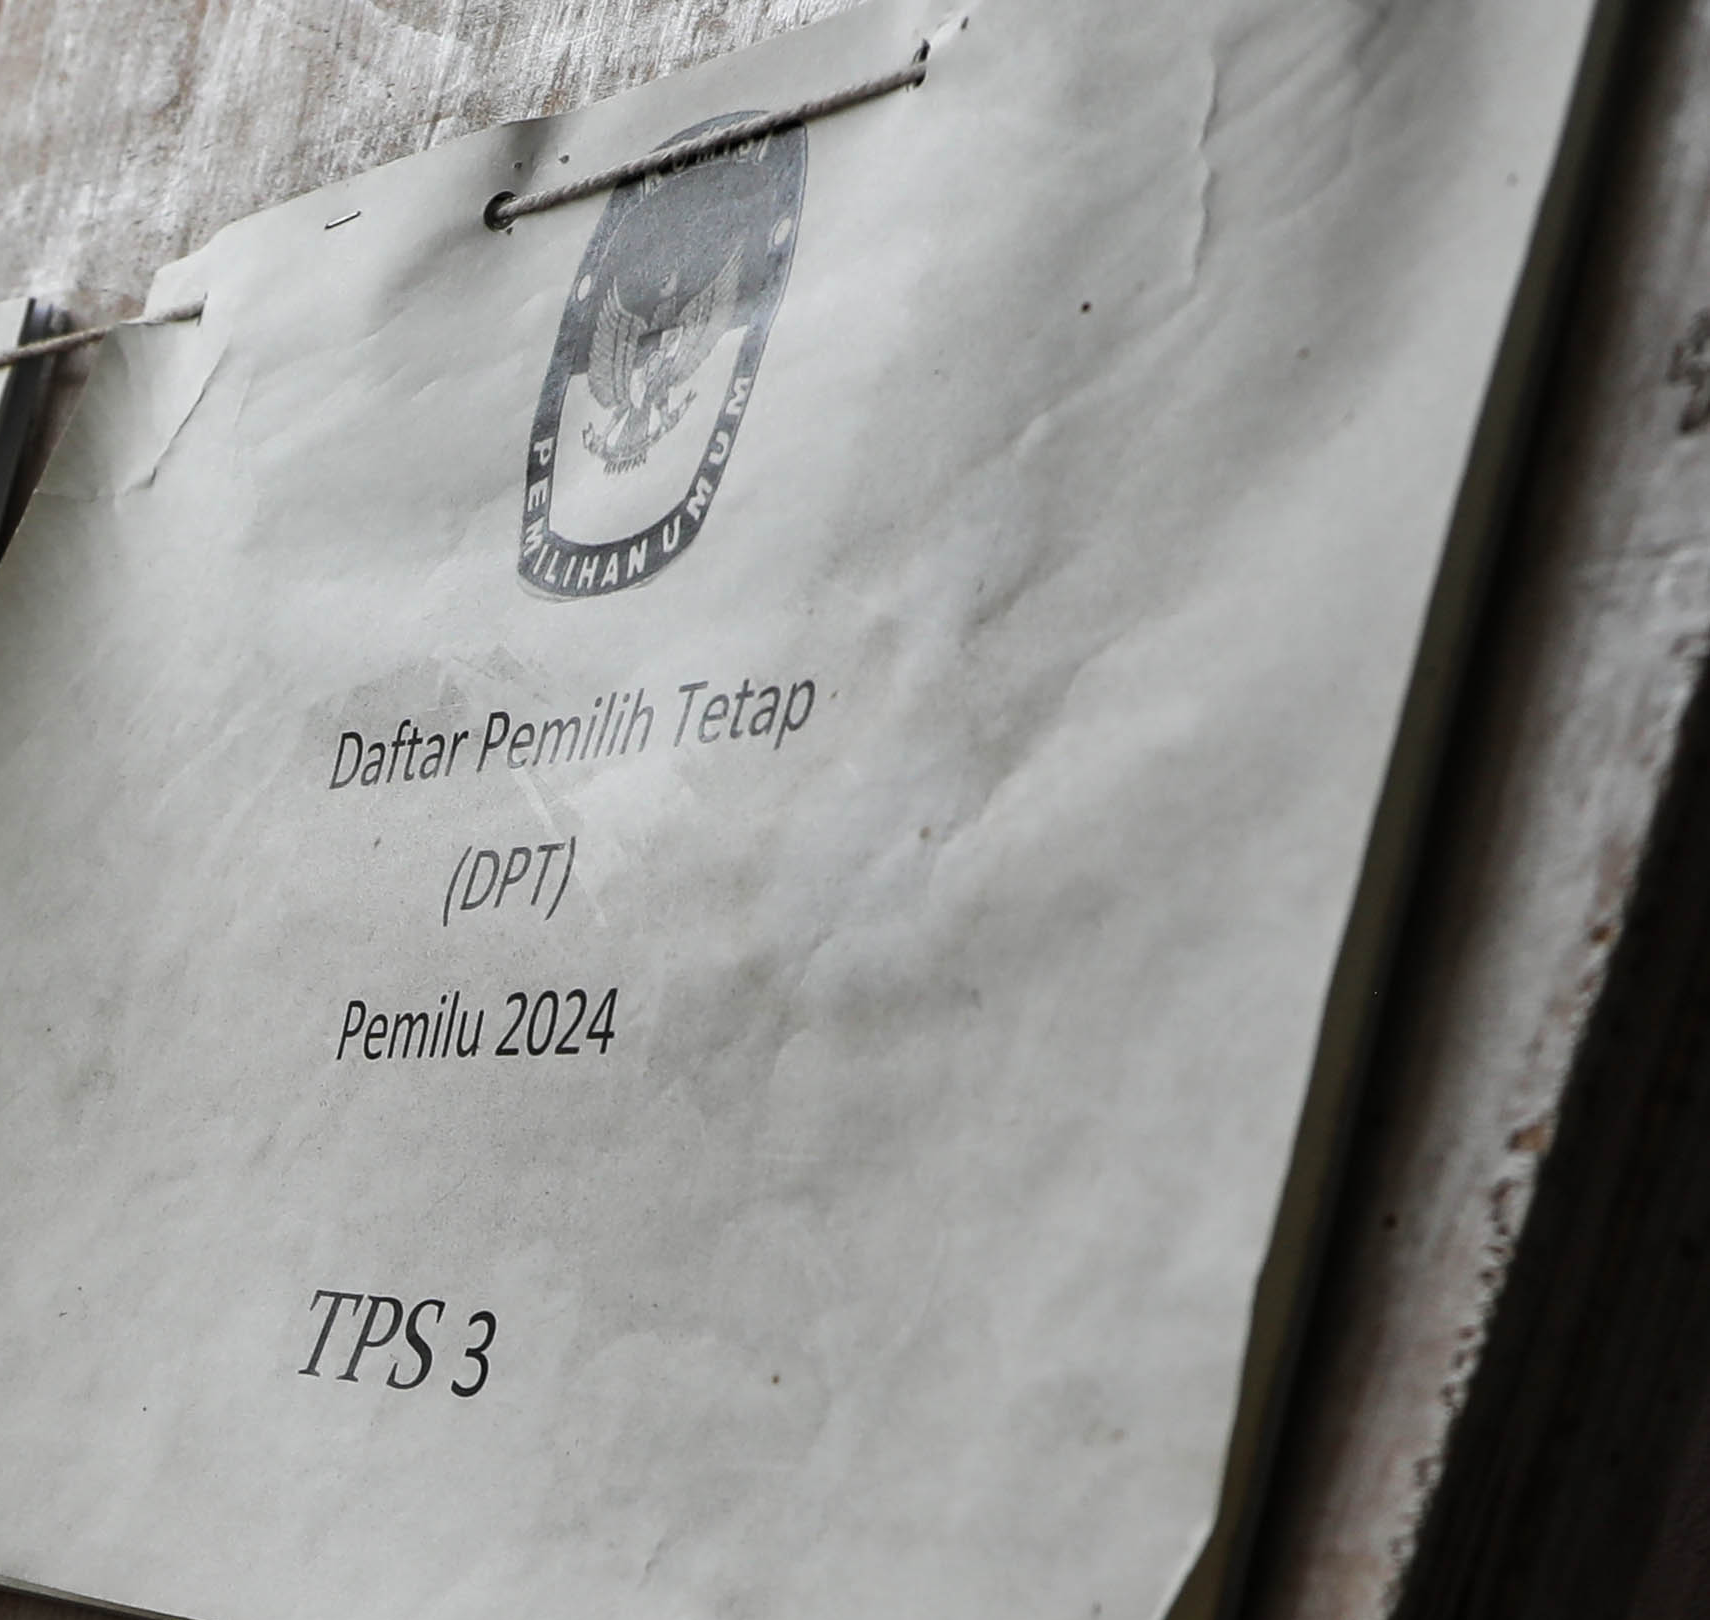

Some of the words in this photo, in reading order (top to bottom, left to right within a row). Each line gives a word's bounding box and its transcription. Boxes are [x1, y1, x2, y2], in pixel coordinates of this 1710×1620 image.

[522, 436, 646, 590] PEMILIHAN
[661, 376, 752, 552] UMUM
[329, 718, 469, 790] Daftar
[476, 687, 656, 774] Pemilih
[671, 677, 818, 751] Tetap
[442, 836, 577, 927] (DPT)
[336, 991, 483, 1061] Pemilu
[495, 987, 619, 1057] 2024
[298, 1288, 446, 1391] TPS
[451, 1310, 497, 1398] 3
